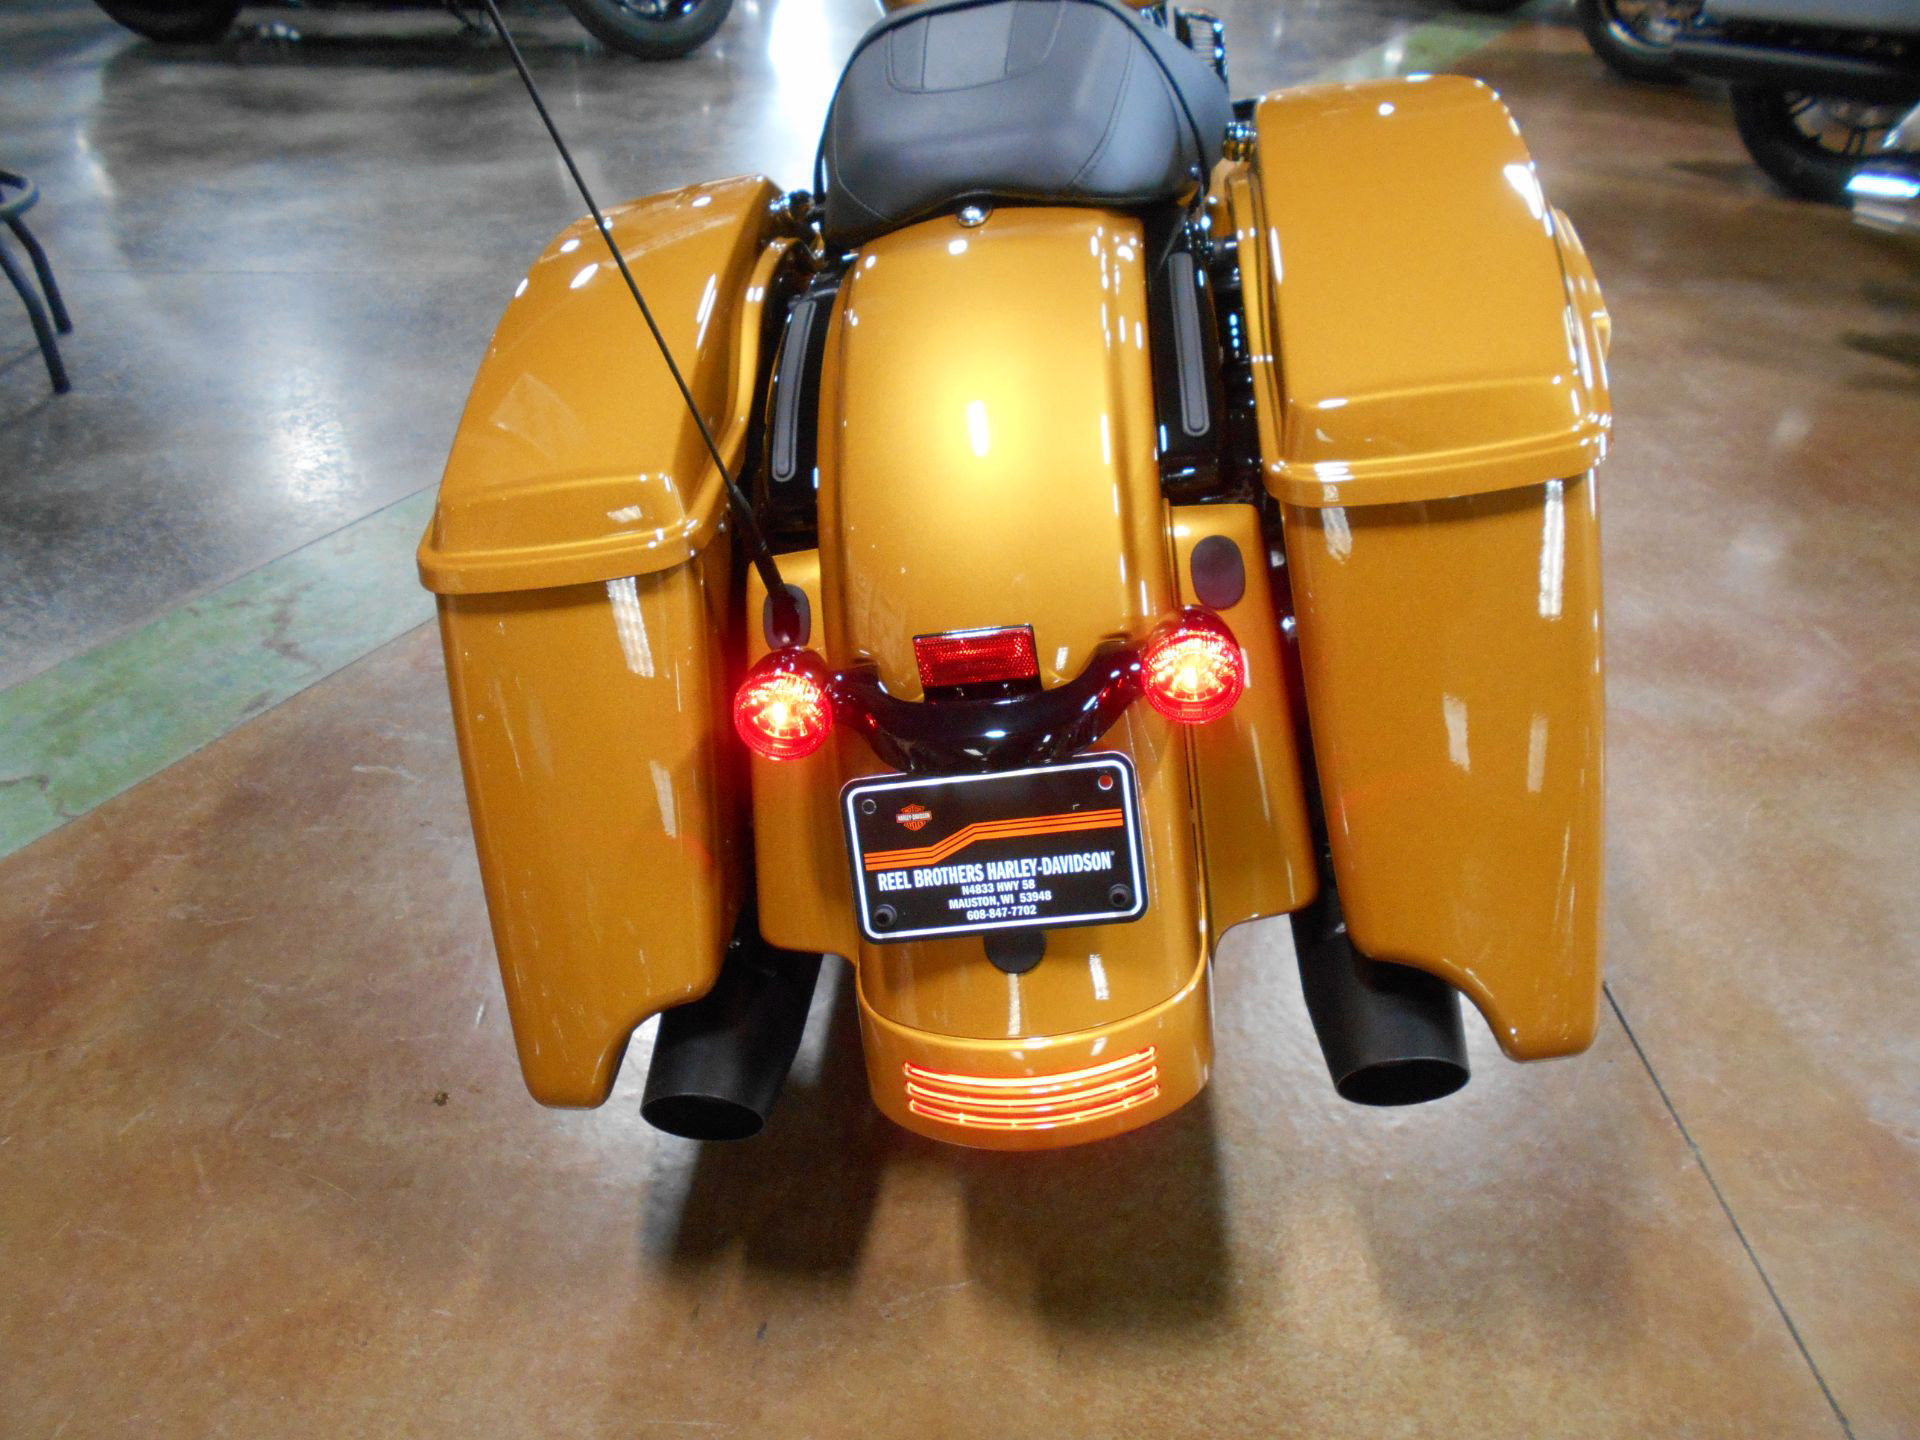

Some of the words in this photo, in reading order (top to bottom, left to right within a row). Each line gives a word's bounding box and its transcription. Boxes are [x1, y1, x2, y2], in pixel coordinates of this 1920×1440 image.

[877, 871, 912, 892] REEL
[913, 863, 985, 888] BROTHERS
[986, 851, 1112, 881] HARLEY-DAVIDSON
[961, 884, 994, 896] N4833
[996, 880, 1020, 893] HWY
[1021, 879, 1036, 890] 58
[948, 895, 1000, 910] MAUSTON,
[1000, 893, 1015, 905] WI
[1019, 890, 1052, 903] 53948
[966, 904, 1037, 921] 608-847-7702
